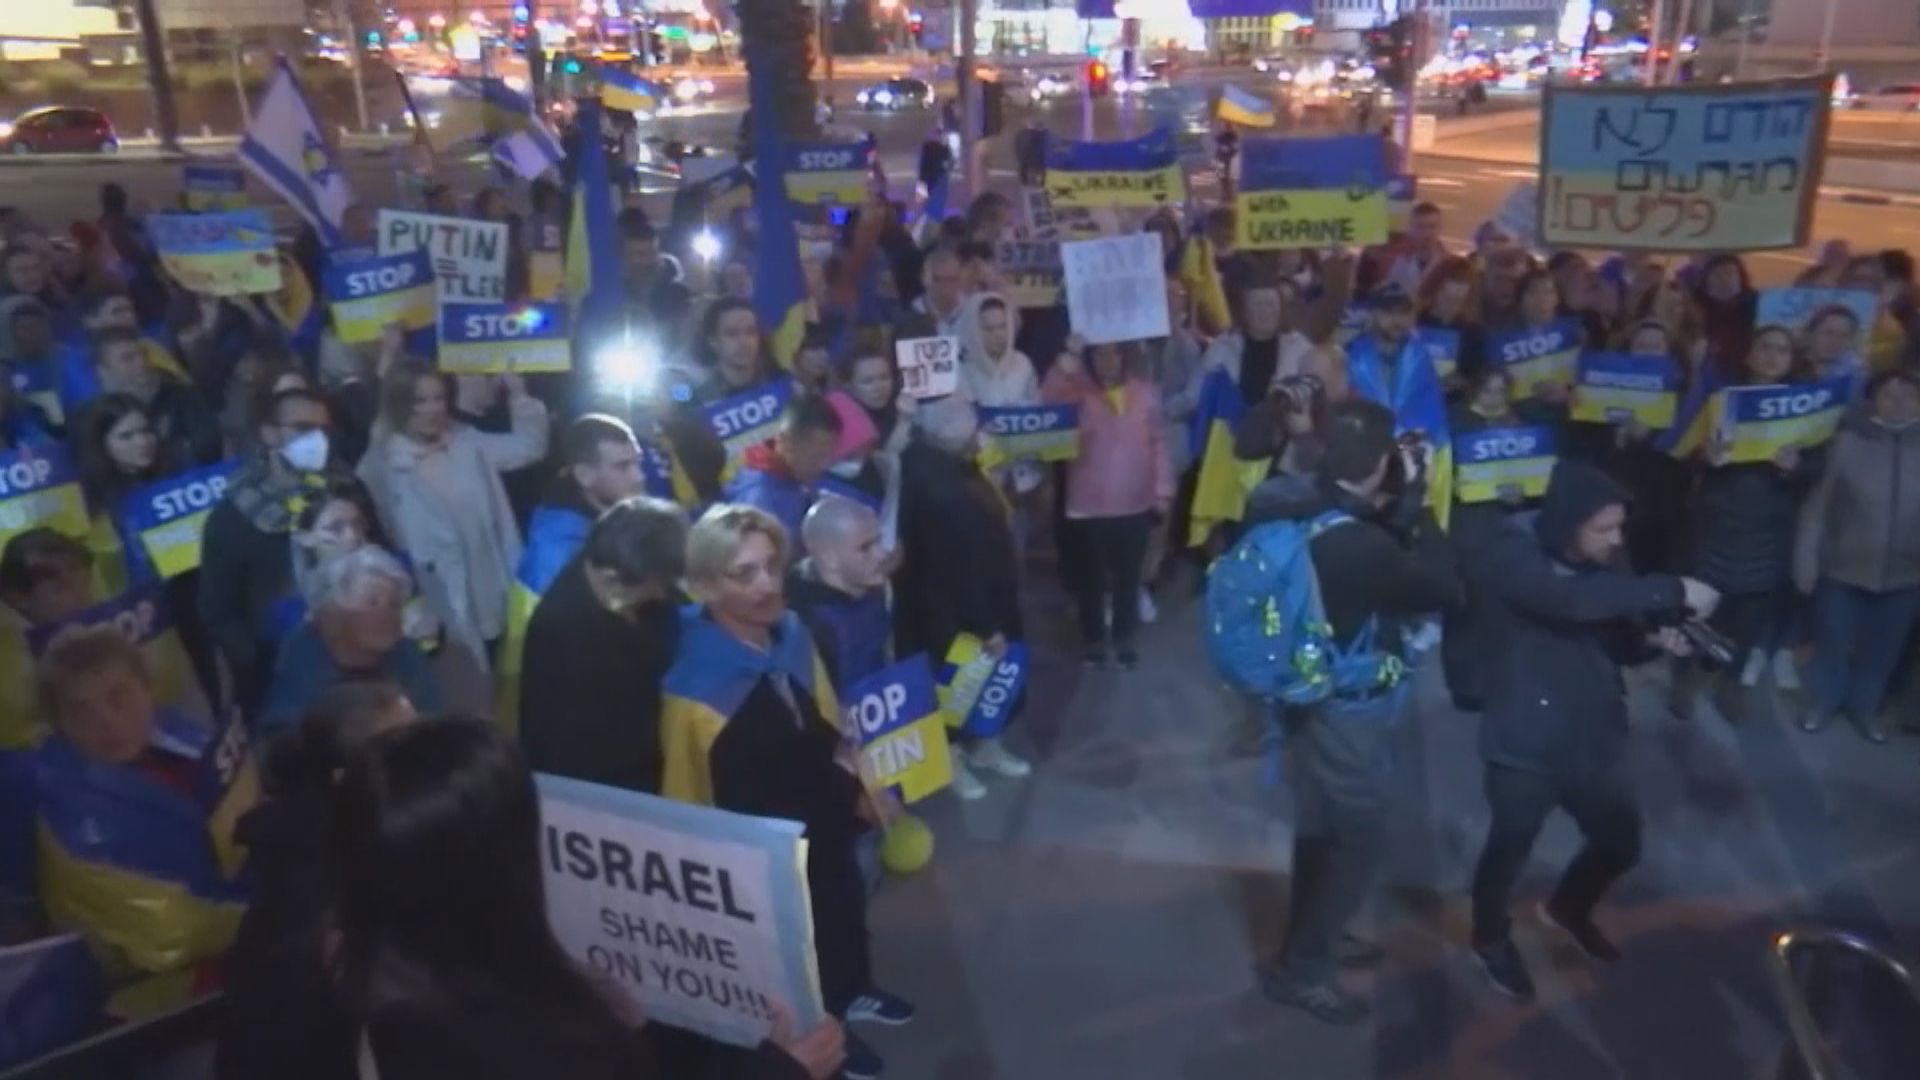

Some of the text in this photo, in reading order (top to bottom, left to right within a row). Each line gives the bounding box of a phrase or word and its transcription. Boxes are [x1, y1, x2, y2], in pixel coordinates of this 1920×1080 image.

[1592, 94, 1679, 157] לא
[799, 151, 853, 168] STOP
[1070, 172, 1168, 194] UKRAINE
[389, 220, 498, 261] PUTIN
[1247, 217, 1355, 243] UKRAINE
[345, 263, 415, 296] STOP
[1503, 332, 1564, 362] STOP
[711, 394, 779, 437] STOP
[993, 413, 1058, 433] STOP
[1759, 389, 1832, 418] STOP
[1473, 436, 1537, 460] STOP
[0, 459, 50, 494] TOP
[151, 475, 227, 520] STOP
[979, 661, 1020, 719] STOP
[847, 683, 907, 744] TOP
[870, 728, 924, 778] TIN
[547, 826, 755, 924] ISRAEL
[601, 907, 739, 971] SHAME
[586, 945, 643, 984] ON
